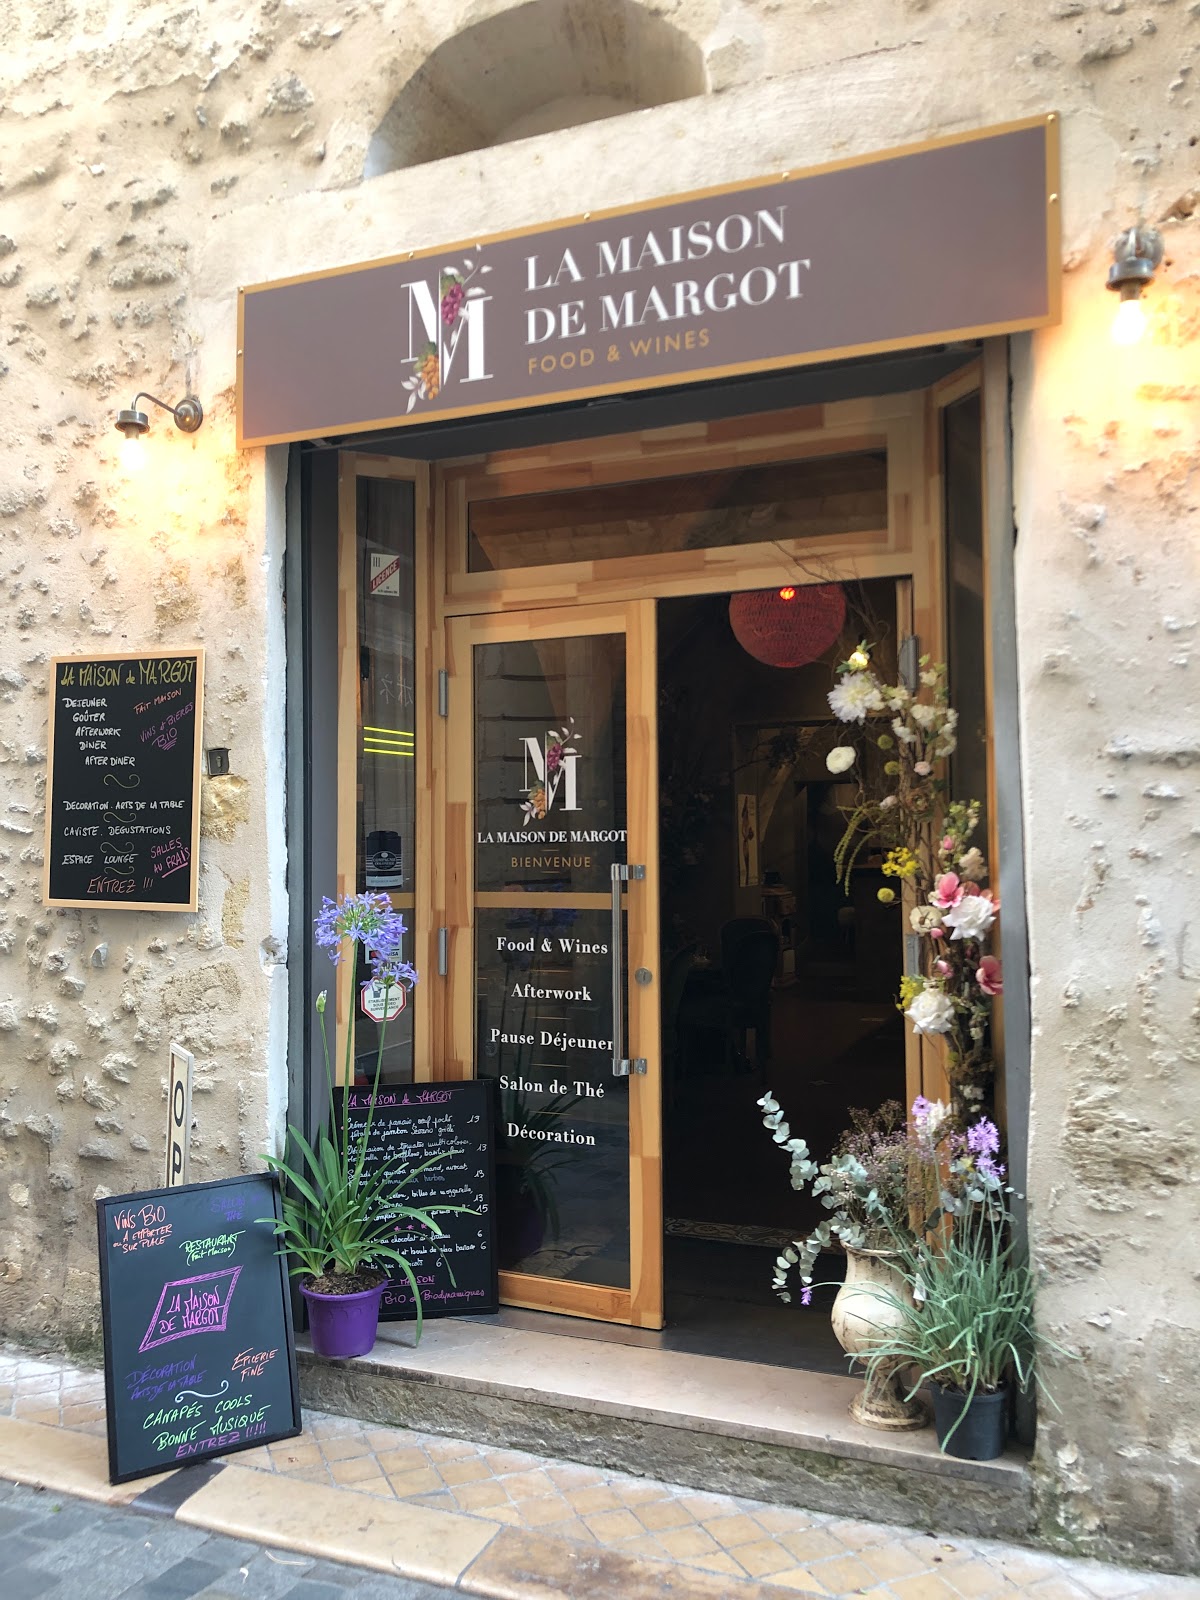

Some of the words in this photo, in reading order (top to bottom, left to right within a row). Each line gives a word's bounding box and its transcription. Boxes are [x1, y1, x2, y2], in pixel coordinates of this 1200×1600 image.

[524, 247, 586, 292] LA
[596, 205, 789, 278] MAISON
[524, 300, 586, 345] DE
[599, 259, 811, 331] MARGOT
[528, 348, 595, 375] FOOD
[607, 344, 620, 362] &
[630, 328, 711, 358] WINES
[372, 560, 398, 590] LICENCE
[126, 669, 136, 685] de
[138, 659, 197, 686] MARGOT
[62, 697, 108, 709] DEJEUNER
[75, 727, 121, 738] AFTERWORK
[85, 756, 108, 766] AFTER
[115, 800, 134, 810] ARTS
[135, 801, 146, 810] DE
[150, 801, 158, 809] LA
[159, 800, 185, 809] TABLE
[477, 831, 494, 843] LA
[496, 831, 546, 843] MAISON
[549, 830, 567, 843] DE
[570, 830, 627, 842] MARGOT
[62, 854, 94, 866] ESPACE
[104, 853, 139, 864] LOUNGE
[511, 856, 591, 868] BIENVENUE
[87, 876, 136, 894] ENTREZ
[496, 936, 535, 952] Food
[541, 937, 552, 952] &
[558, 938, 608, 954] Wines
[511, 983, 592, 1001] Afterwork
[490, 1028, 535, 1045] Pause
[540, 1031, 613, 1052] Déjeuner
[499, 1075, 544, 1093] Salon
[549, 1079, 568, 1095] de
[573, 1081, 605, 1098] Thé
[381, 1127, 409, 1141] jambon
[507, 1122, 596, 1146] Décoration
[477, 1143, 488, 1152] 13
[473, 1169, 485, 1178] 13
[473, 1194, 484, 1202] 13
[476, 1204, 489, 1213] 15
[122, 1241, 138, 1254] SUR
[141, 1234, 172, 1248] PLACE
[178, 1230, 246, 1252] RESTAURANT
[480, 1241, 486, 1250] 6
[436, 1258, 442, 1267] 6
[166, 1293, 181, 1314] LA
[421, 1289, 485, 1305] Biodynamiques
[159, 1315, 176, 1334] DE
[182, 1306, 225, 1328] MARGOT
[215, 1394, 253, 1414] COOLS
[152, 1420, 207, 1451] BONNE
[175, 1432, 241, 1458] ENTREZ
